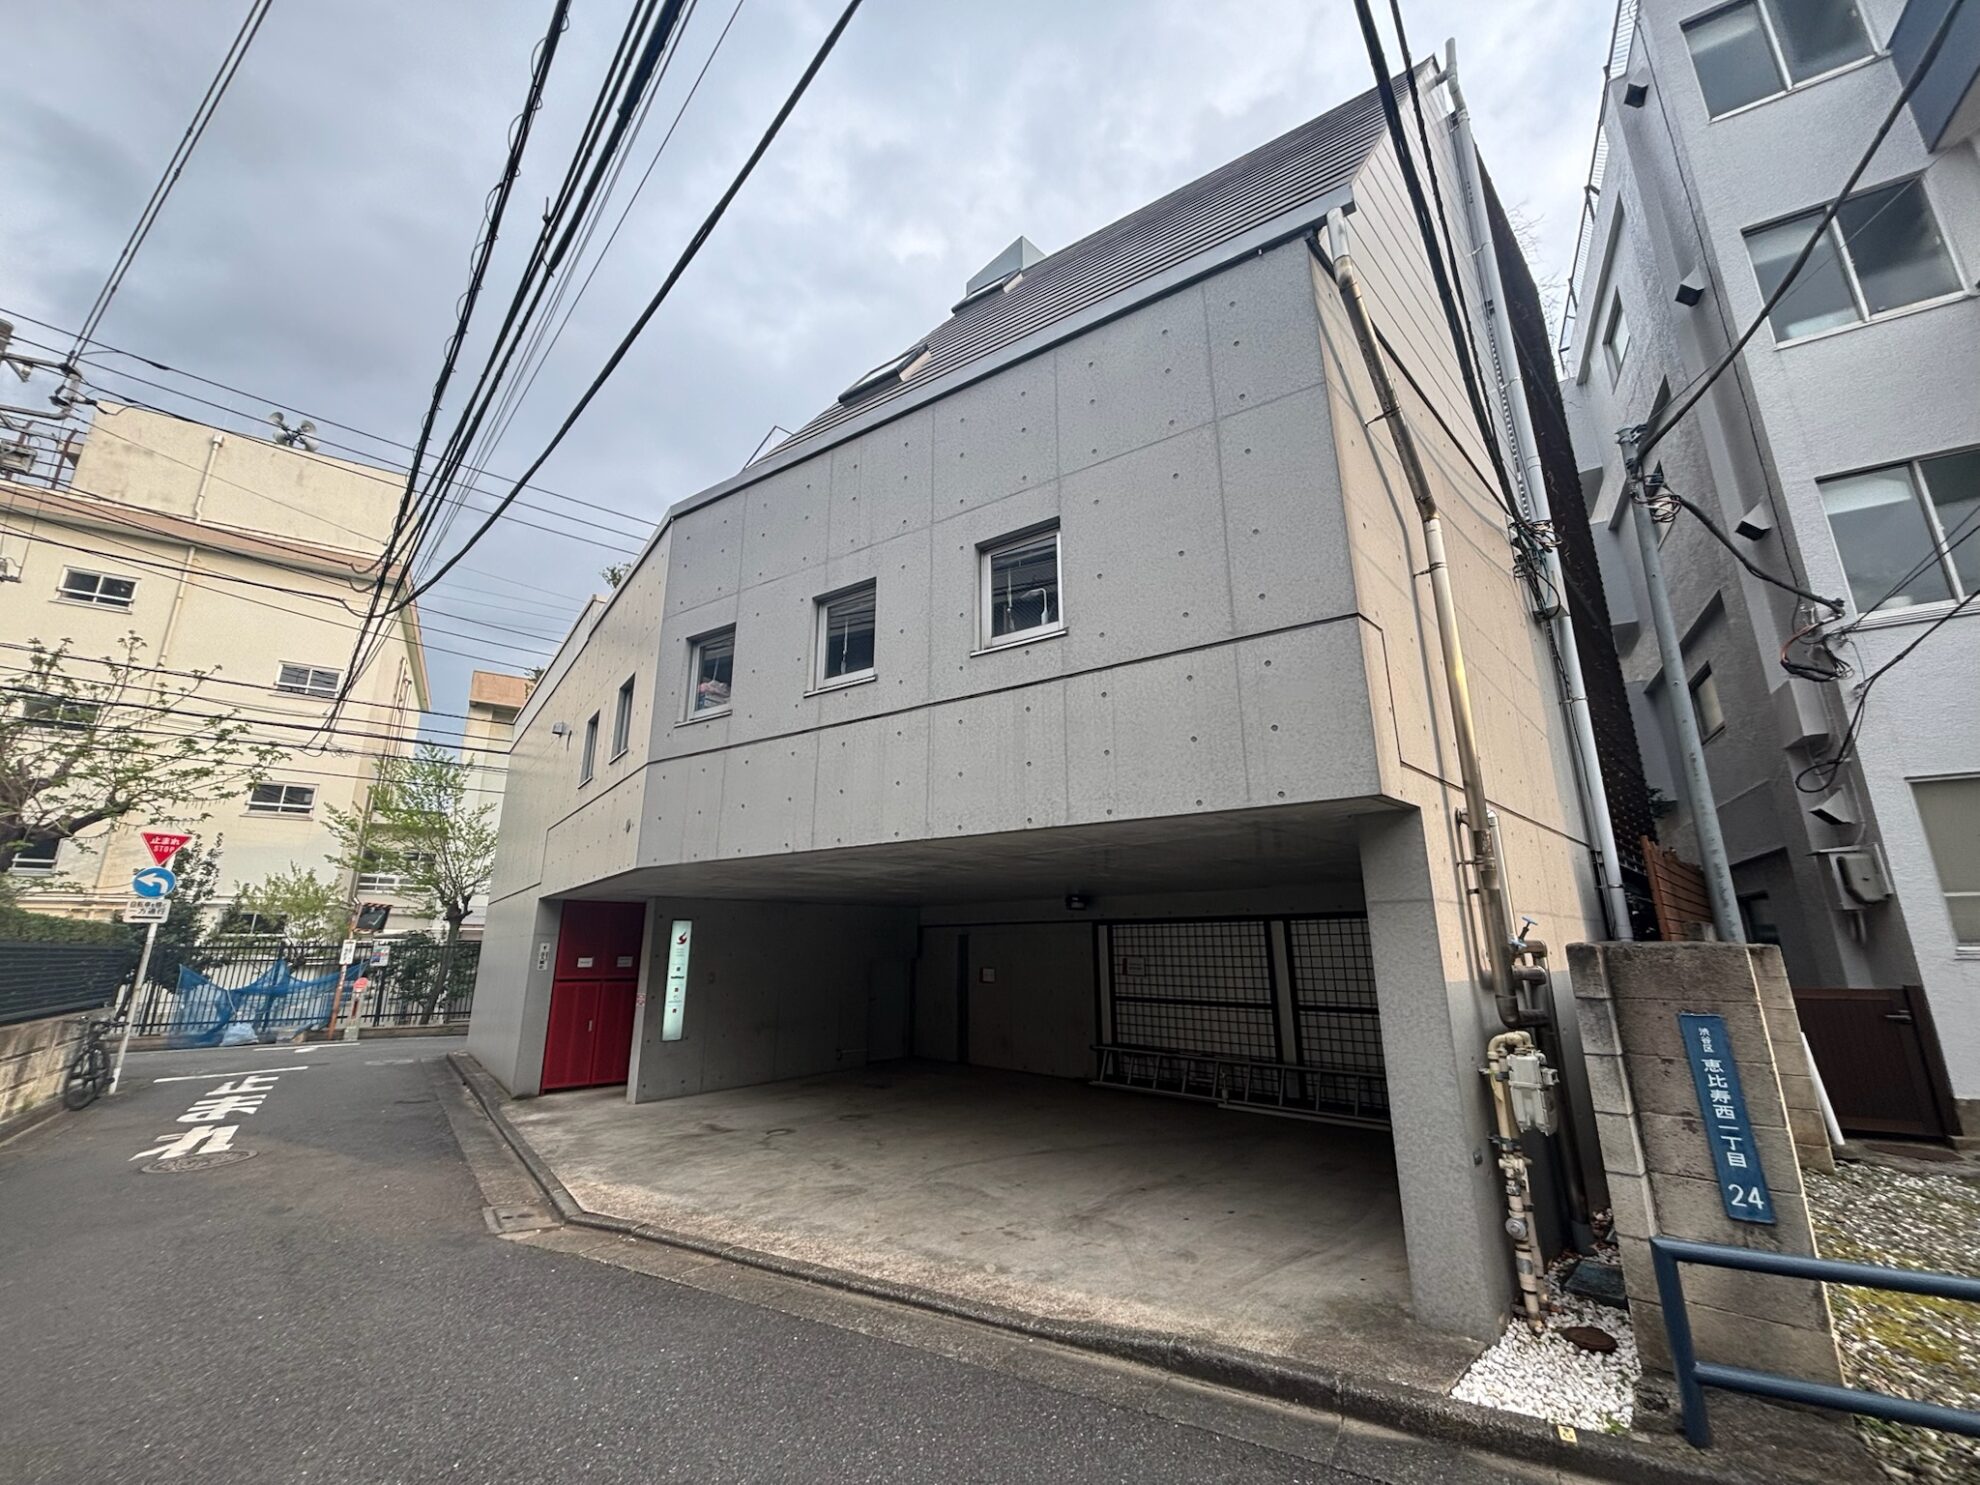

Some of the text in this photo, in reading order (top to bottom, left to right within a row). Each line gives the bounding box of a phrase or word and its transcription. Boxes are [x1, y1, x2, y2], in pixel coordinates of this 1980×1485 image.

[150, 836, 180, 846] 止まれ
[128, 1075, 280, 1161] 止まれ
[1698, 1027, 1765, 1211] 渋谷区 恵比寿西一丁目 24
